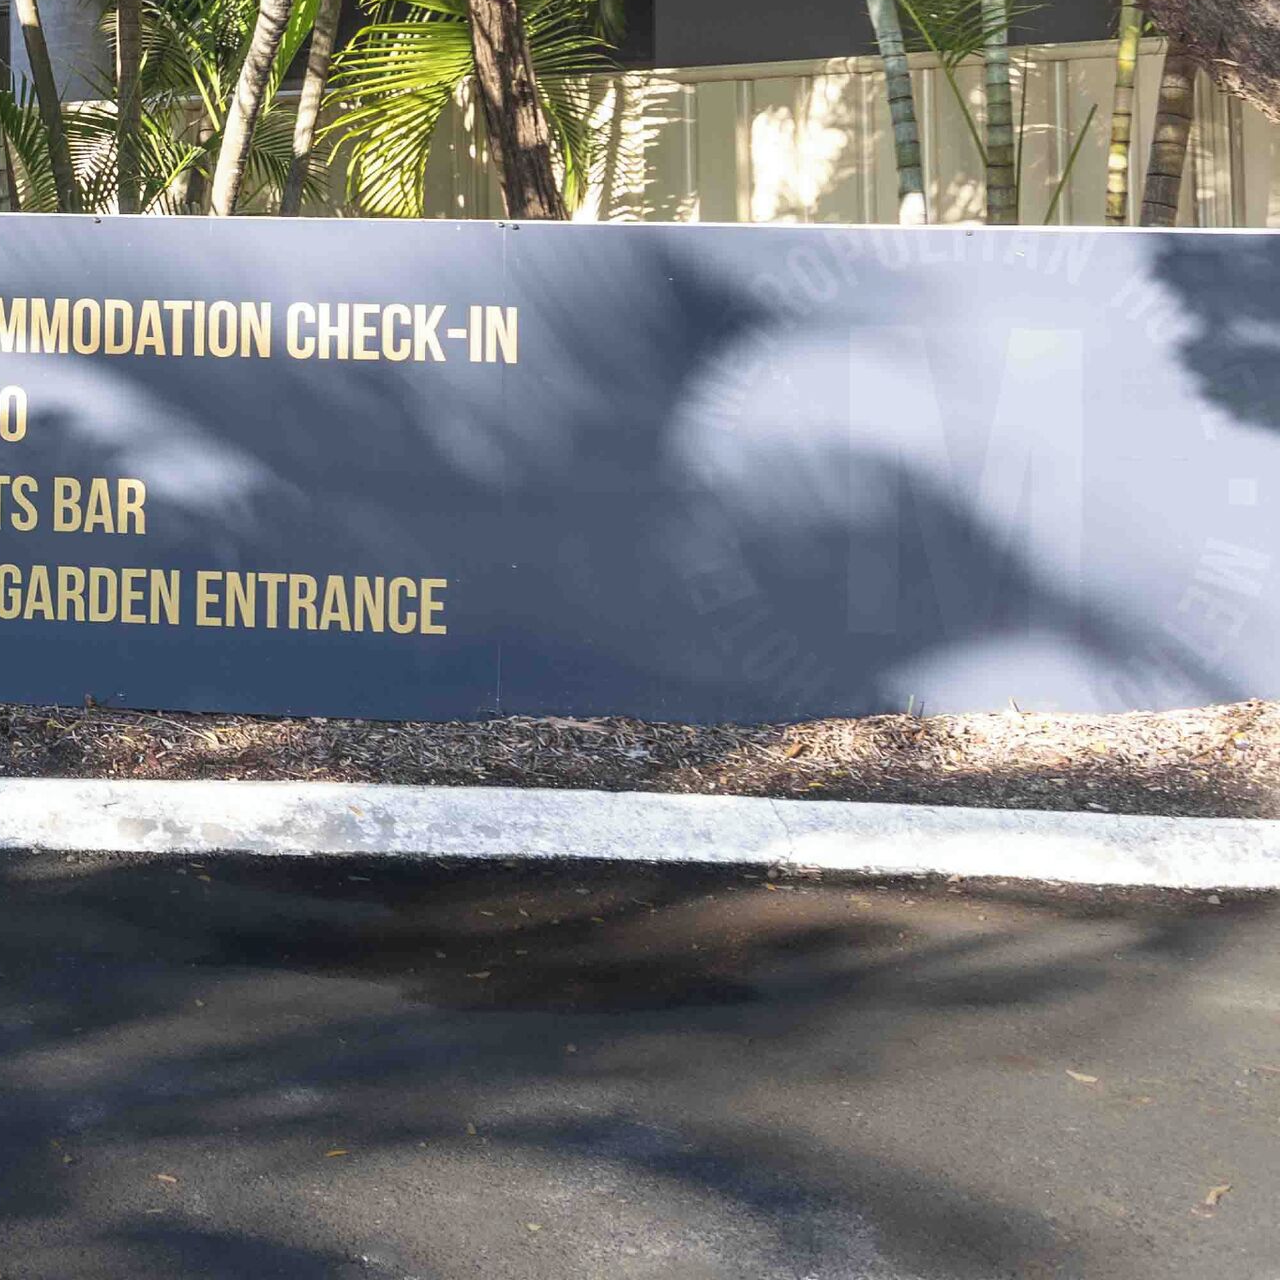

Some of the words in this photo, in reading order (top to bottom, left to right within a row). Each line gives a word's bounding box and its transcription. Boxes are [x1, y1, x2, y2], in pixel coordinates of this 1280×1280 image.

[286, 301, 519, 365] CHECK-IN
[52, 475, 147, 535] BAR
[196, 570, 449, 636] ENTRANCE
